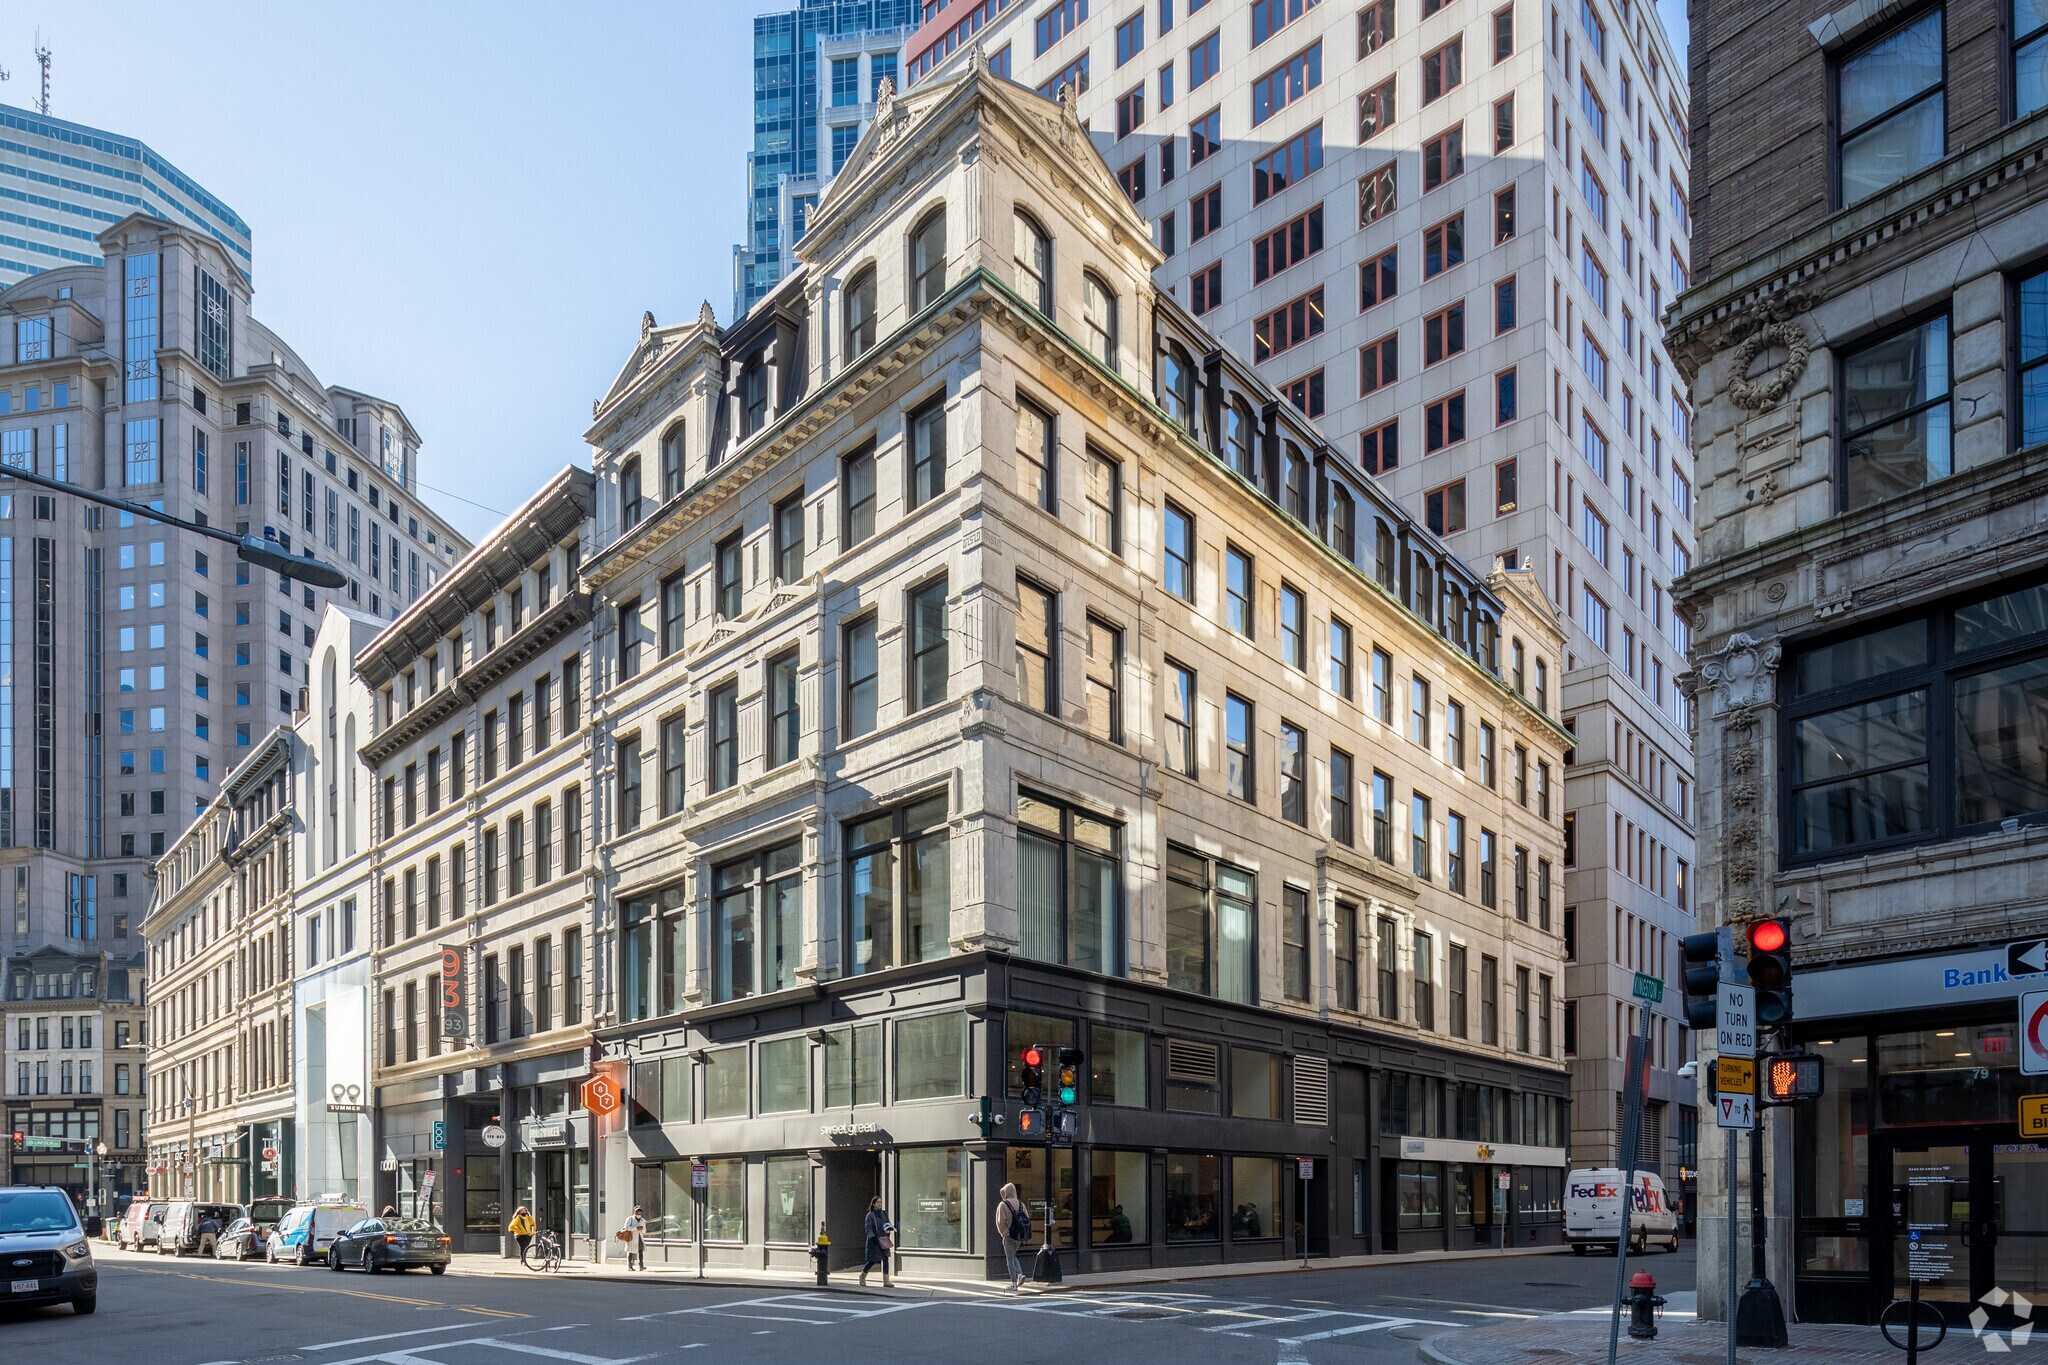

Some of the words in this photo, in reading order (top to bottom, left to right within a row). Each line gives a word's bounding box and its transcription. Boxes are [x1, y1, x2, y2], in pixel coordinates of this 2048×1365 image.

[1944, 962, 2008, 989] Bank
[1634, 974, 1659, 998] KINGSTON
[1729, 993, 1744, 1007] NO
[445, 1019, 461, 1031] 93
[1725, 1011, 1748, 1027] TURN
[1720, 1031, 1733, 1046] ON
[1735, 1031, 1752, 1047] RED
[1983, 1037, 2009, 1053] EXIT
[1720, 1063, 1742, 1074] TURNING
[1972, 1068, 1989, 1080] 79
[1720, 1076, 1743, 1087] VEHICLES
[1734, 1105, 1741, 1114] TO
[435, 1122, 443, 1149] noon
[820, 1122, 876, 1136] sweetgreen
[1571, 1183, 1618, 1198] FedEx
